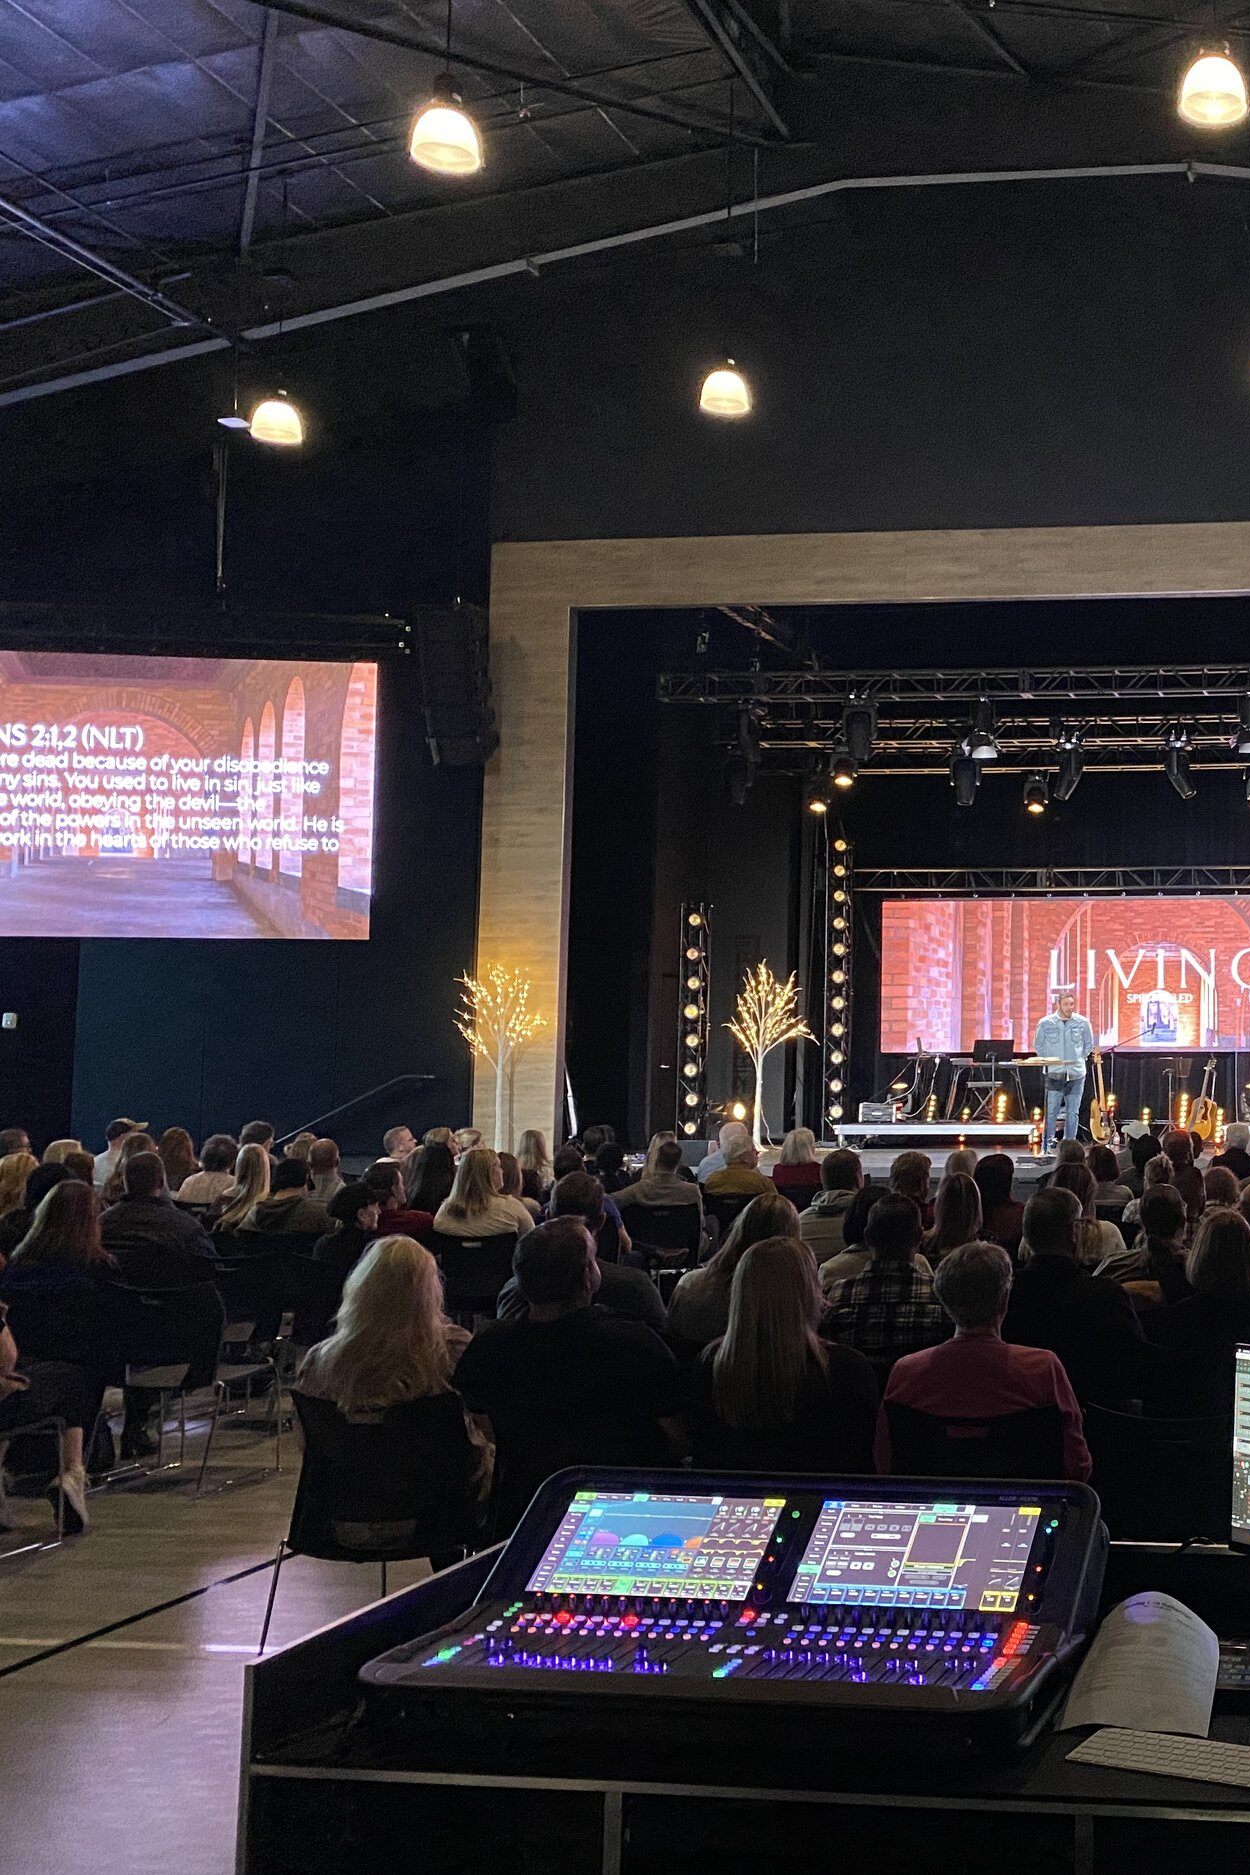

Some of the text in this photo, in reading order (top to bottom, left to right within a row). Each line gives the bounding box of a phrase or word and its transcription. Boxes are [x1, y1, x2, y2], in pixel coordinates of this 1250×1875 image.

[31, 724, 77, 748] 2:1,2
[81, 723, 144, 751] (NLT)
[0, 752, 329, 778] re dead because of your disobedience
[0, 773, 20, 790] ny
[64, 772, 98, 790] You
[102, 772, 146, 790] used
[149, 774, 168, 790] to
[172, 774, 200, 790] live
[205, 774, 220, 792] in
[254, 776, 287, 796] just
[292, 778, 320, 794] like
[11, 792, 65, 808] world,
[69, 793, 140, 812] obeying
[146, 793, 175, 810] the
[0, 809, 20, 826] of
[20, 810, 52, 826] the
[56, 811, 121, 830] powers
[125, 811, 140, 828] in
[145, 813, 176, 830] the
[179, 815, 242, 831] unseen
[303, 816, 327, 832] He
[332, 815, 344, 832] is
[0, 829, 340, 852] ork in the hearts of those who refuse to
